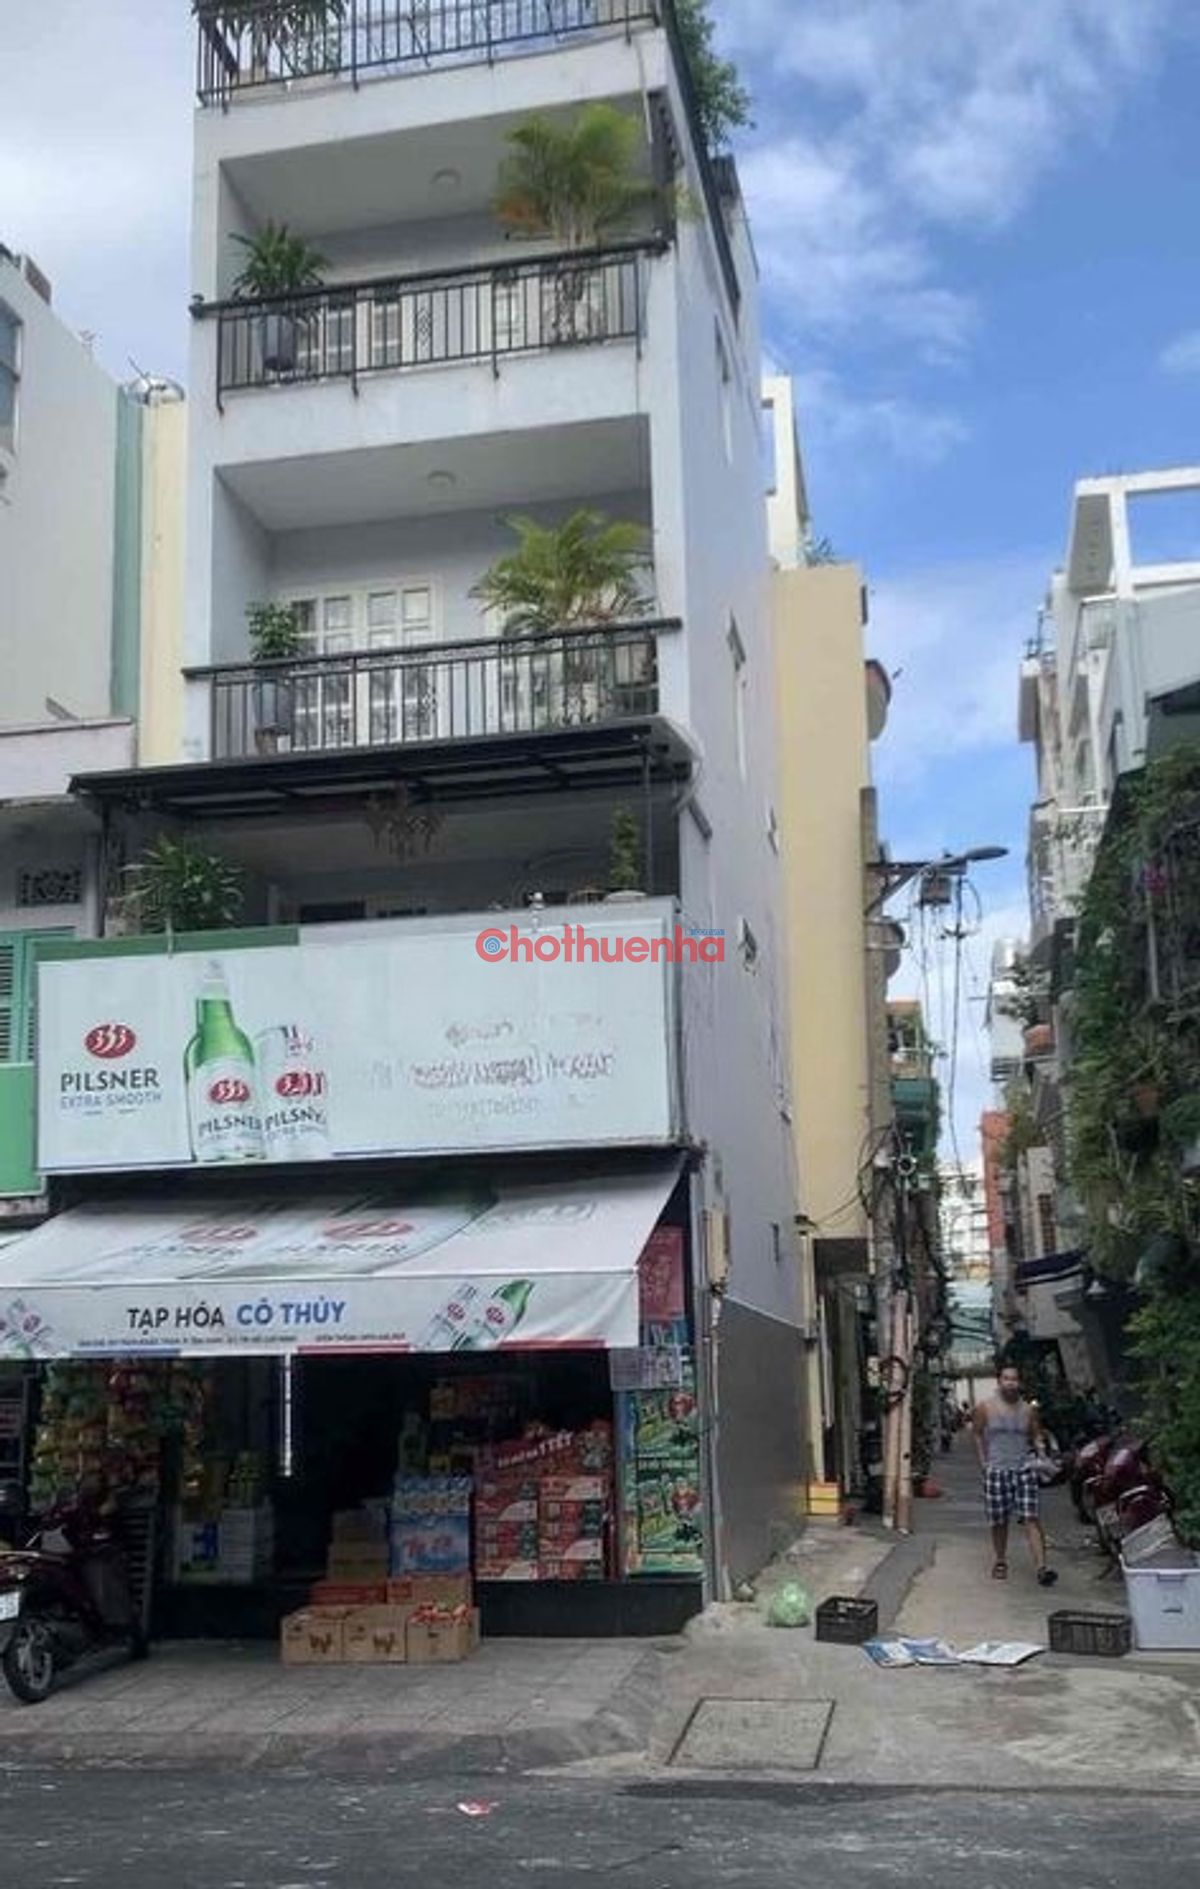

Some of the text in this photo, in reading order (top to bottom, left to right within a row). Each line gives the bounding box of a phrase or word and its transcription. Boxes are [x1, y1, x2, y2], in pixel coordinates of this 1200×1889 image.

[61, 1067, 160, 1092] PILSNER
[127, 1295, 346, 1335] TẠP HÓA CÔ THỦY
